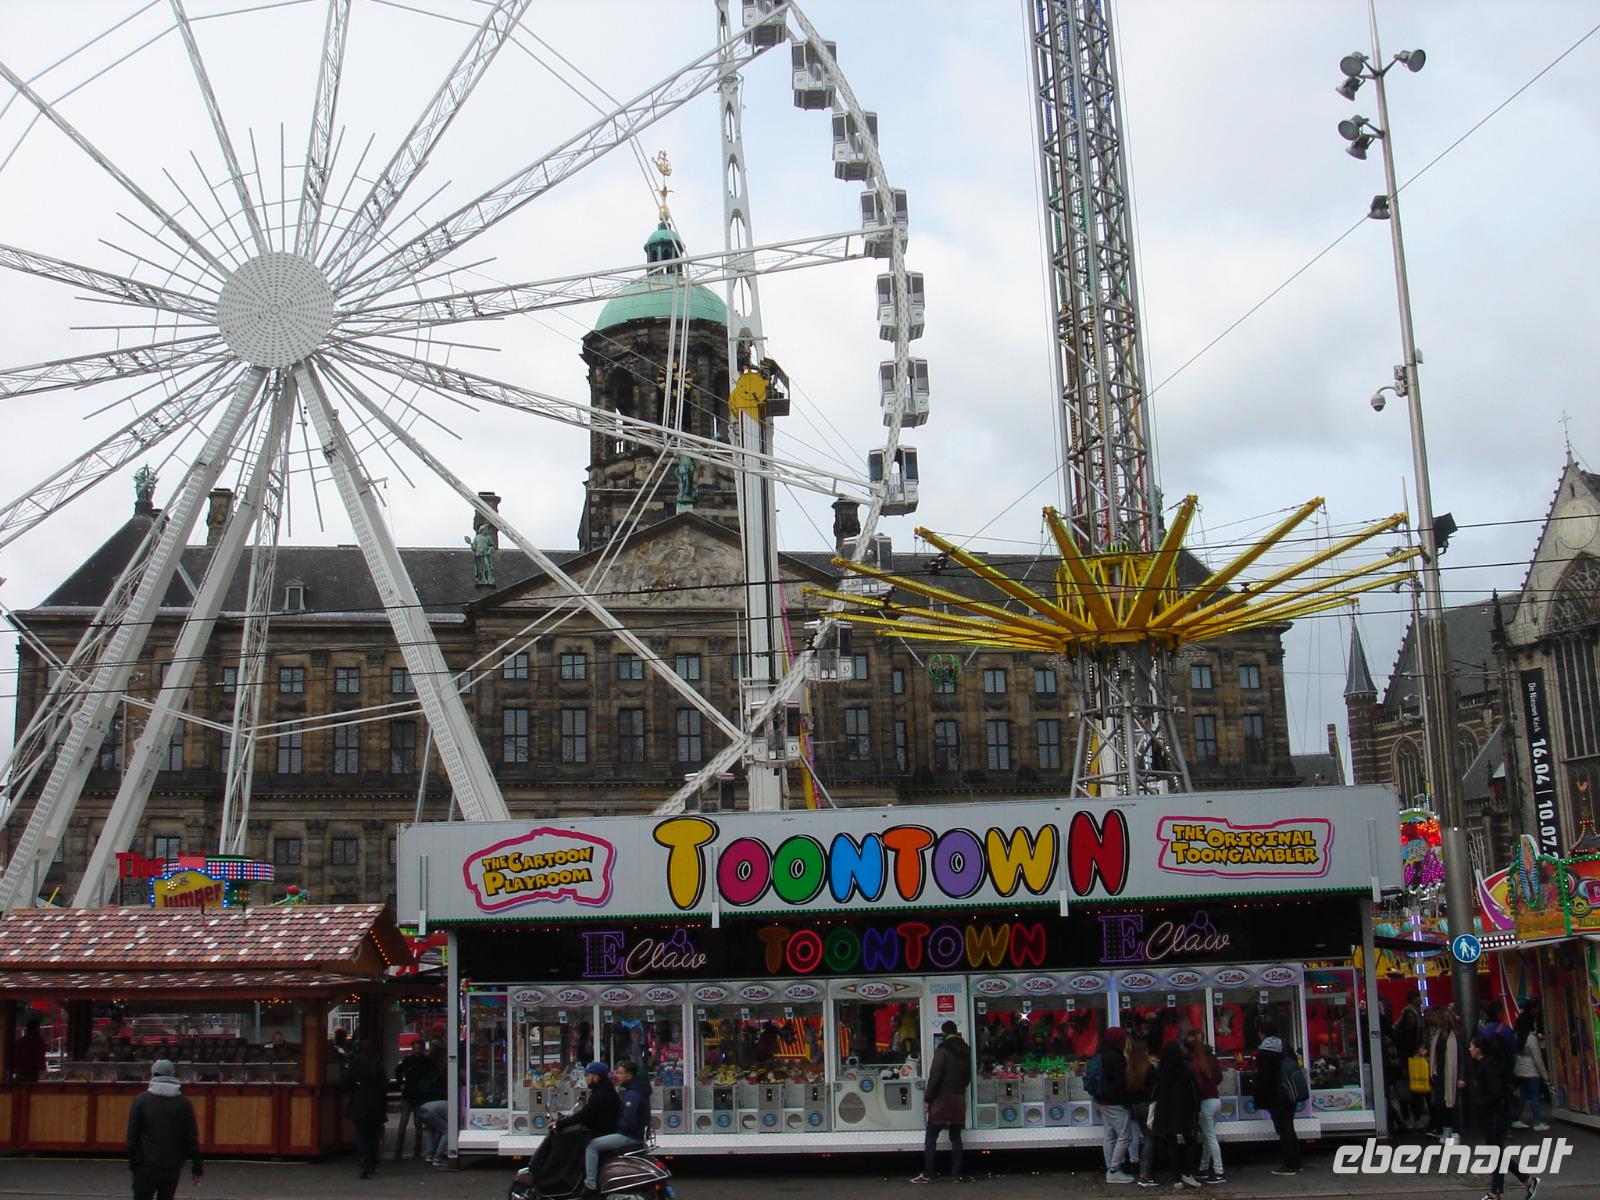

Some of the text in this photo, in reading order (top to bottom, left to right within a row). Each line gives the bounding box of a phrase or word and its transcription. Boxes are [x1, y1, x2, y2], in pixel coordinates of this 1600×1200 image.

[1528, 682, 1536, 692] De
[1532, 716, 1541, 733] Kerk
[1531, 738, 1550, 786] 16.04
[1173, 824, 1316, 848] THE ORIGINAL
[115, 852, 166, 881] The
[482, 846, 594, 873] THE CARTOON
[653, 810, 1130, 910] TOONTOWN
[1171, 842, 1319, 866] TOONGAMBLER
[483, 868, 593, 896] PLAYROOM
[757, 922, 1047, 973] TOONTOWN
[1146, 921, 1230, 960] Claw
[625, 938, 708, 975] Claw
